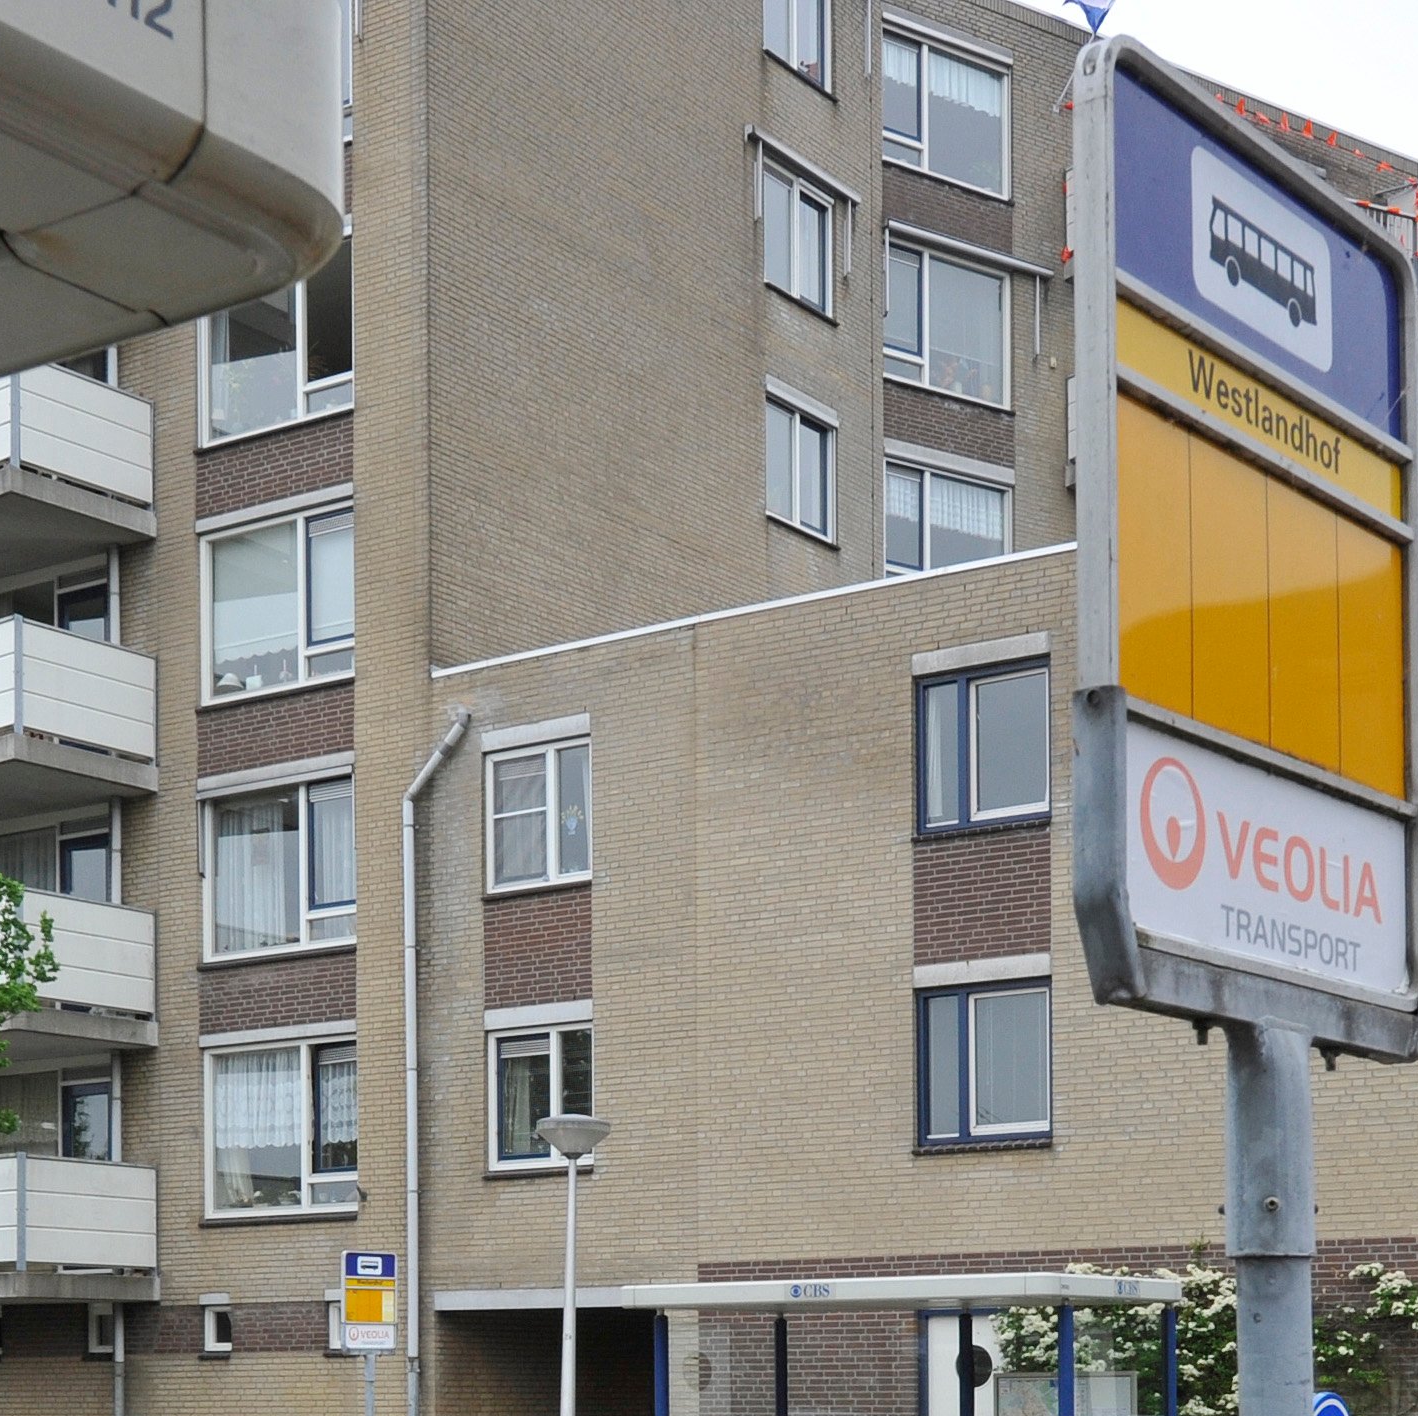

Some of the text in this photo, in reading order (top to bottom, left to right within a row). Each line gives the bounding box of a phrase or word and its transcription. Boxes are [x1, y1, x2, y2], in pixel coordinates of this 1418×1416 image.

[1188, 349, 1341, 475] Westlandhof
[1216, 809, 1383, 925] VEOLIA
[1220, 903, 1361, 972] TRANSPORT
[803, 1283, 830, 1298] CBS
